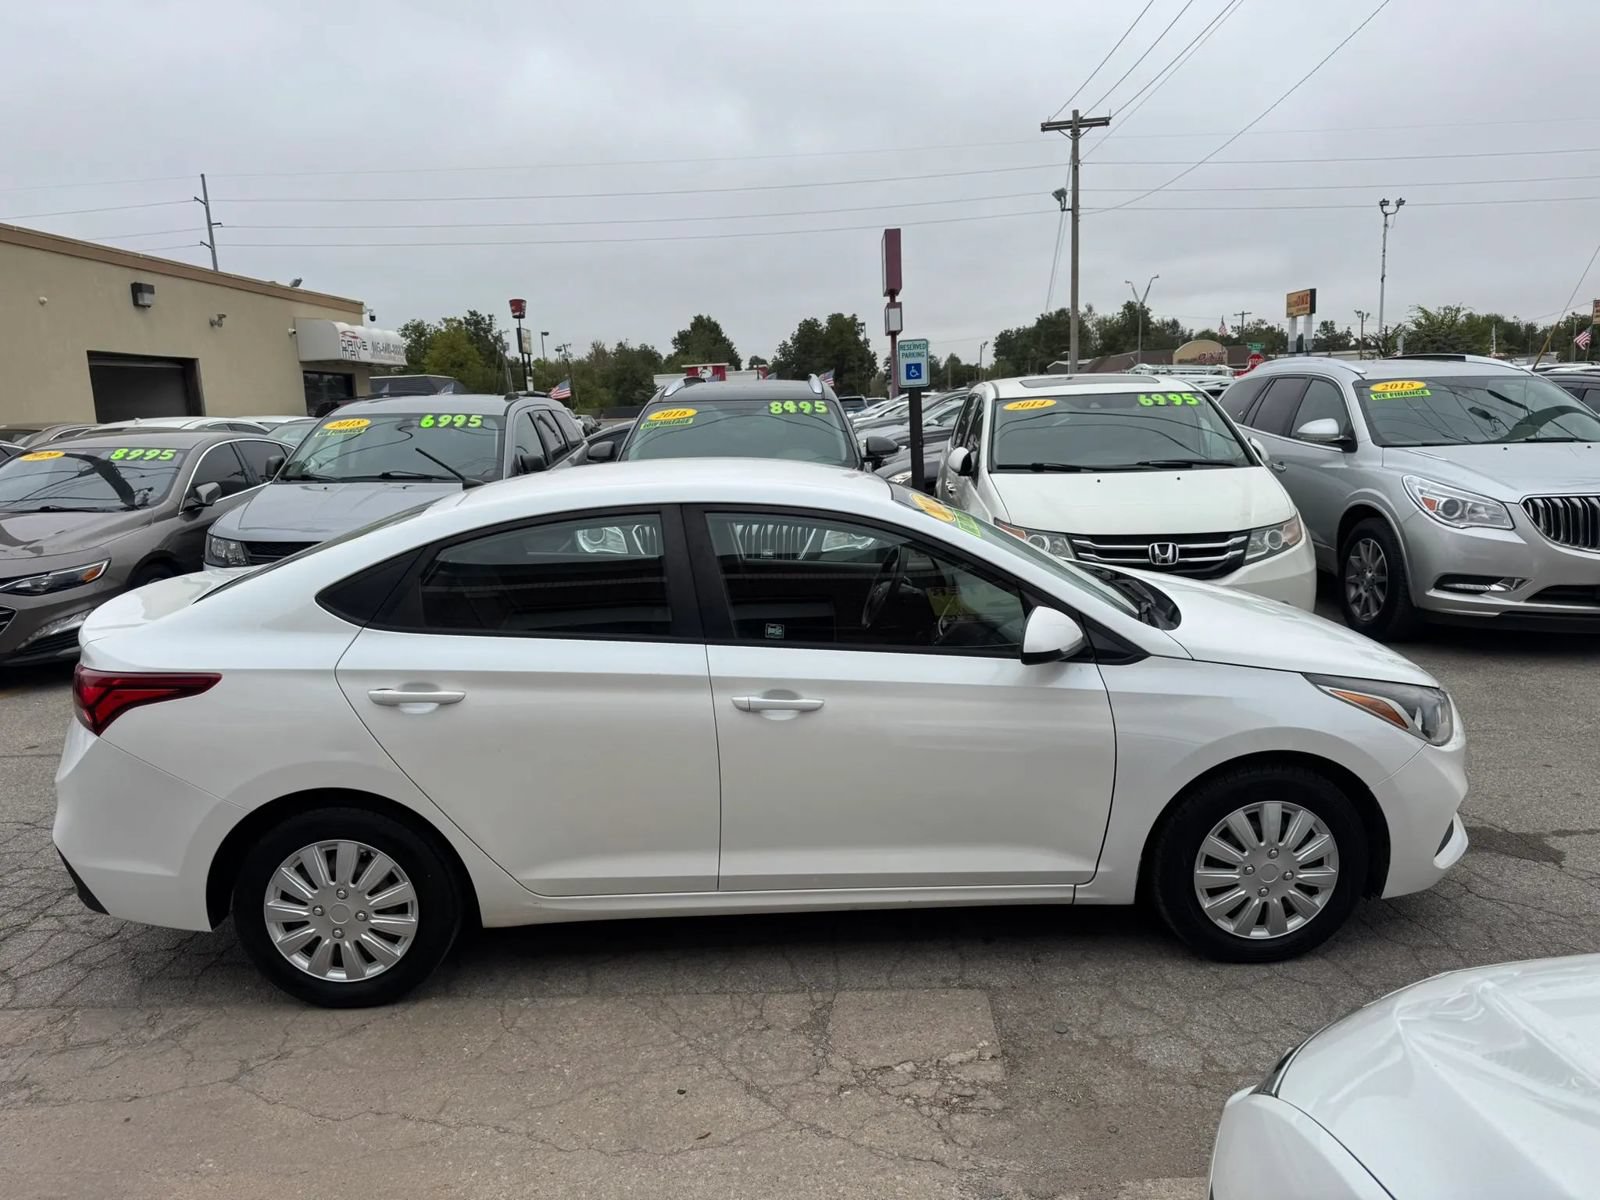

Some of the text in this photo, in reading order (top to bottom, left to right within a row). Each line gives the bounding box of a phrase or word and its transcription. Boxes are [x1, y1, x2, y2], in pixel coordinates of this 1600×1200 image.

[341, 339, 368, 351] DRIVE
[900, 343, 927, 351] RESERVED
[1380, 382, 1415, 390] 2015
[1011, 401, 1048, 409] 2014
[1137, 393, 1200, 406] 6995
[769, 400, 828, 414] 8495
[420, 414, 483, 428] 6995
[655, 411, 688, 419] 2016
[109, 448, 177, 461] 8995
